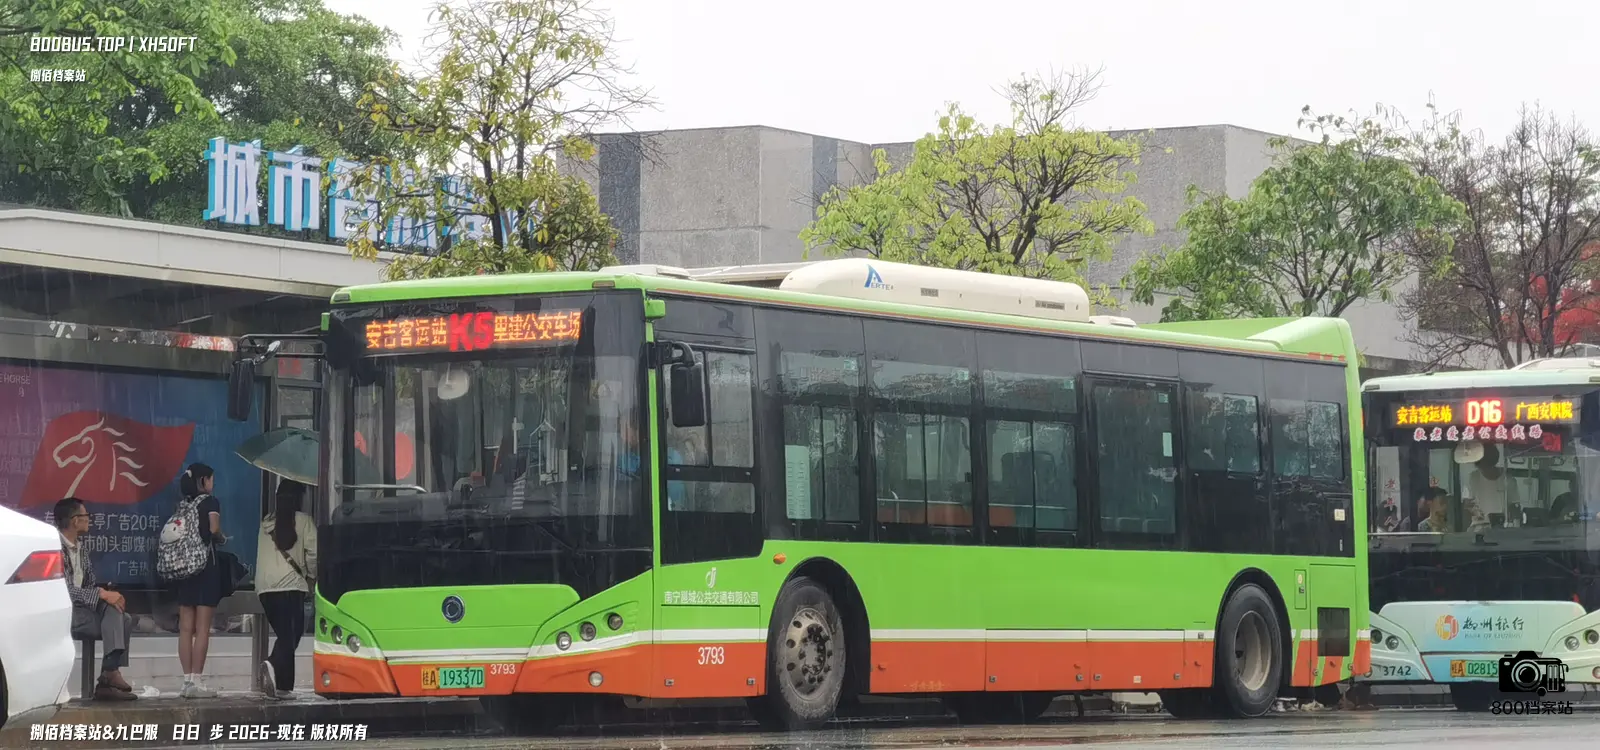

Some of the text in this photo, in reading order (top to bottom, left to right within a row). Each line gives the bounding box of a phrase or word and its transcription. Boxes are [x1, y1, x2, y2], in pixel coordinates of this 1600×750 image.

[366, 311, 582, 351] 安吉客运站 K5 里建公交车场
[1396, 404, 1453, 425] 安吉客运站
[1466, 399, 1503, 424] D16
[697, 646, 725, 665] 3793
[490, 663, 516, 675] 3793
[1382, 665, 1412, 676] 3742
